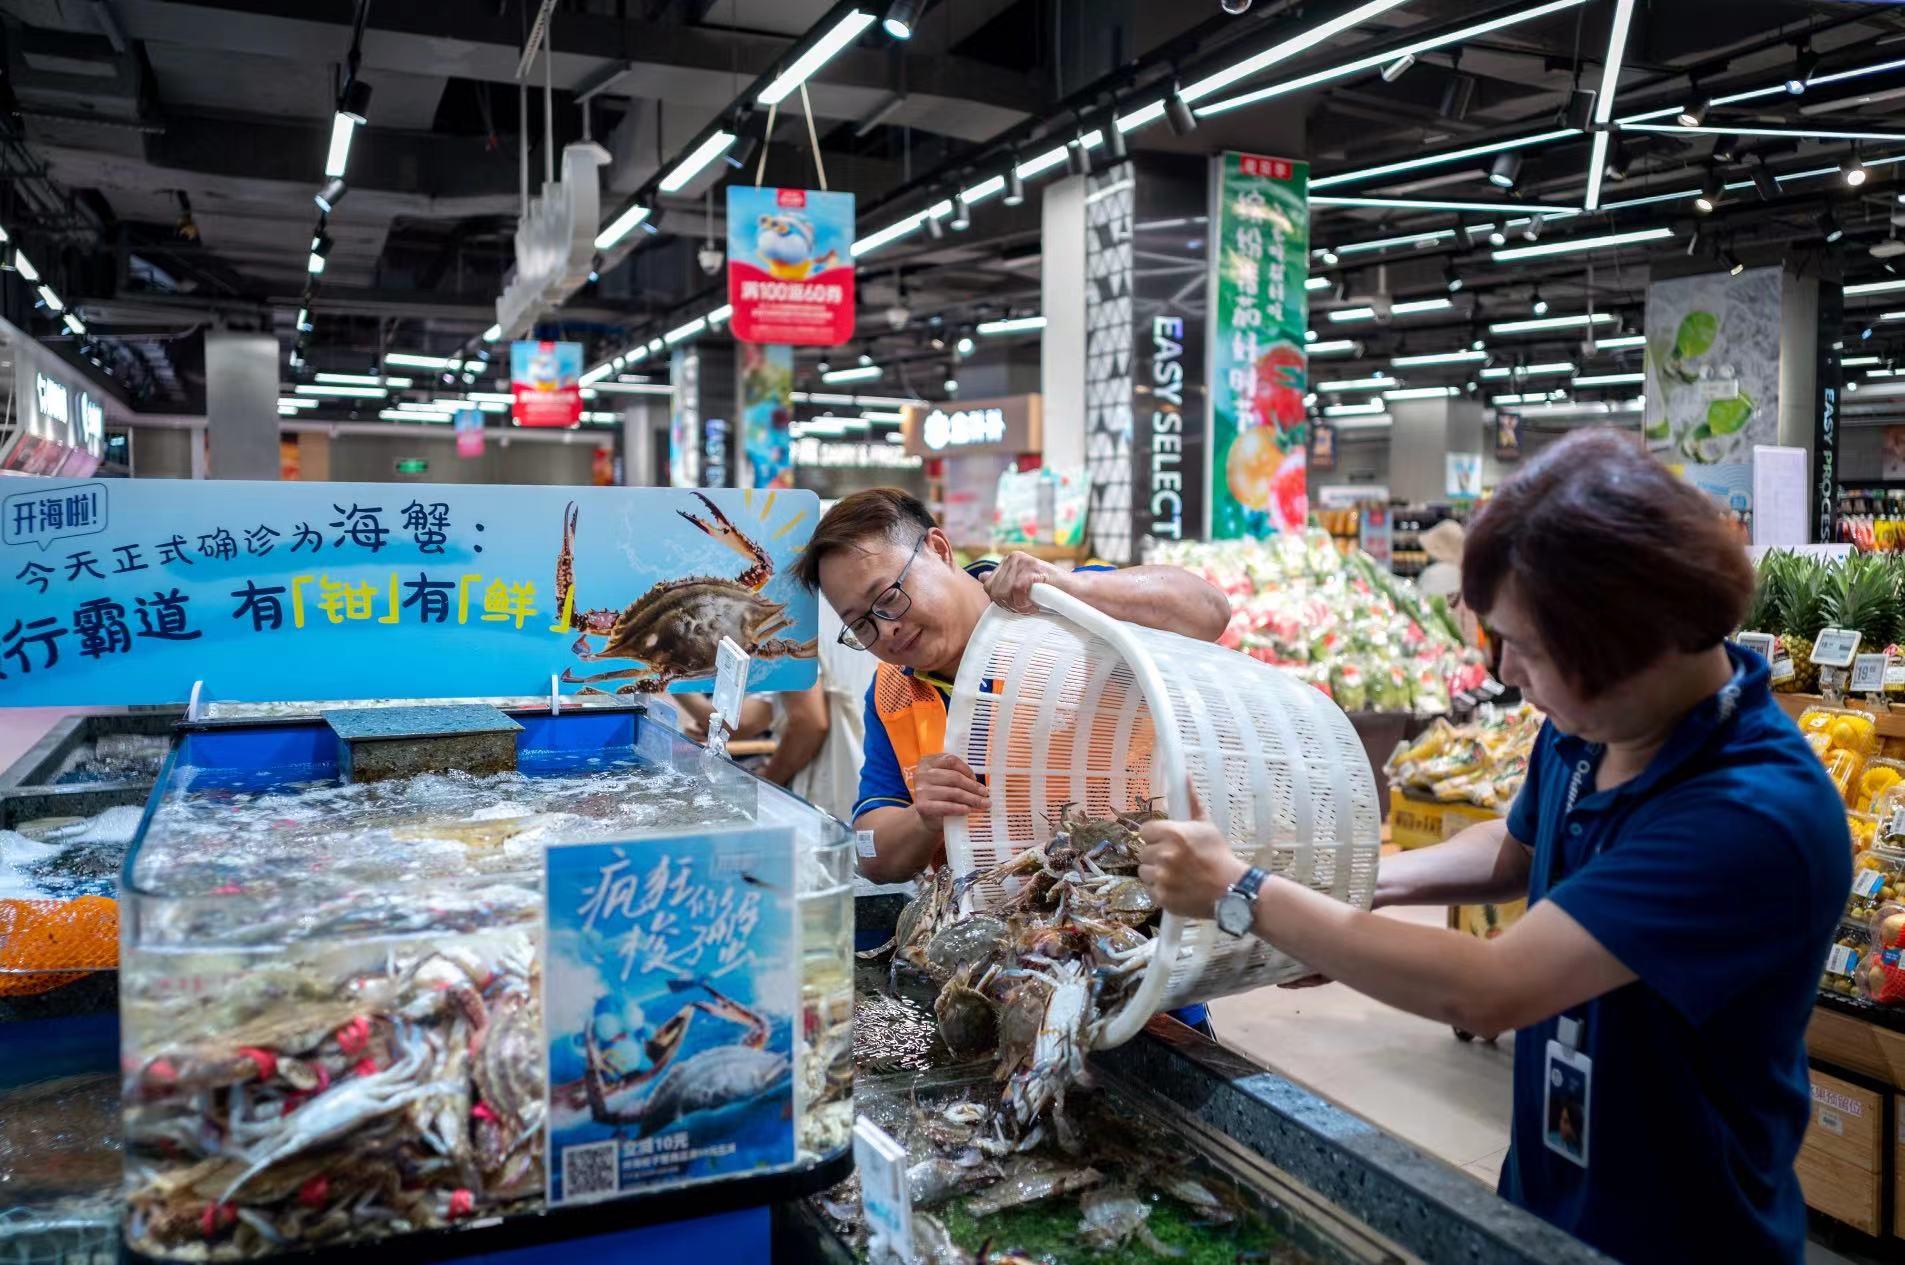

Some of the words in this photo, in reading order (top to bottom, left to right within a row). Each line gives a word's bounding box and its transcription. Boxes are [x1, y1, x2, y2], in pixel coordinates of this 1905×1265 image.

[1153, 316, 1184, 406] EASY
[1824, 388, 1835, 446] EASY
[13, 492, 97, 535] 开海啦!
[1152, 411, 1183, 540] SELECT
[0, 588, 202, 680] 行霸道
